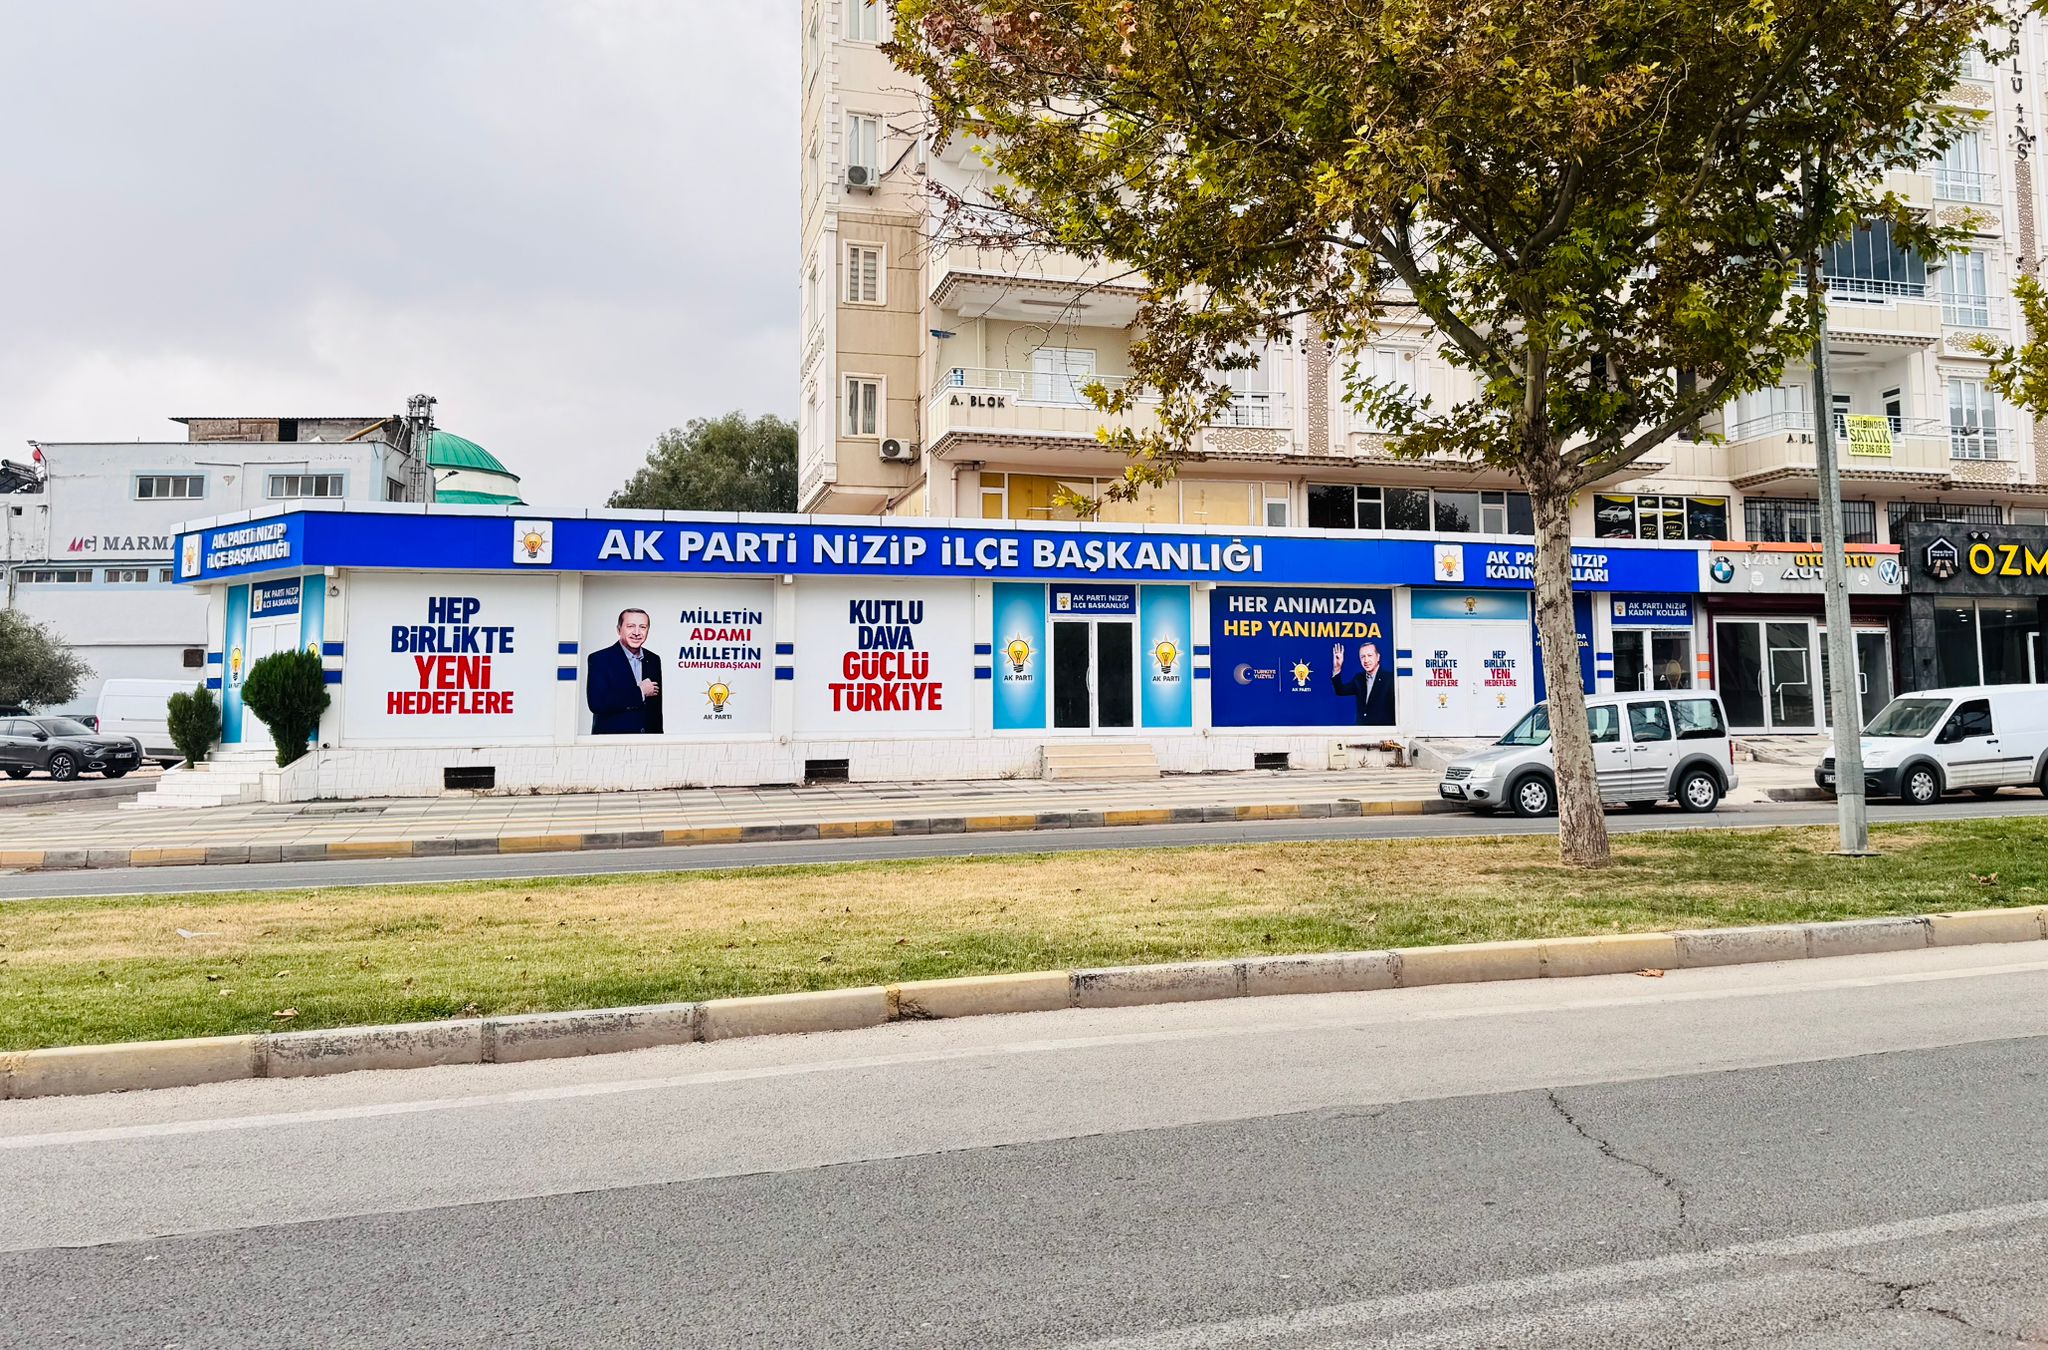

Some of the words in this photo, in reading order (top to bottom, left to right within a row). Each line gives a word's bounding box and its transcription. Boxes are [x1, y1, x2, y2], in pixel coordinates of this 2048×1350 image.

[950, 394, 964, 406] A.
[970, 395, 1005, 408] BLOK
[1847, 417, 1888, 430] SAHİBİNDEN
[1801, 433, 1814, 445] BL
[1849, 428, 1890, 443] SATILIK
[103, 536, 176, 550] MARM
[211, 532, 228, 550] AK
[228, 527, 257, 547] PARTİ
[256, 523, 287, 542] NİZİP
[207, 551, 229, 570] İLÇE
[228, 539, 291, 566] BAŞKANLIĞI
[598, 529, 665, 560] AK
[679, 531, 797, 563] PARTİ
[813, 533, 927, 565] NİZİP
[941, 535, 1019, 569] İLÇE
[1033, 538, 1263, 572] BAŞKANLIĞI
[1486, 551, 1510, 564] AK
[1571, 568, 1609, 582] LLARI
[1781, 568, 1824, 580] AUT
[428, 597, 481, 624] HEP
[849, 599, 924, 624] KUTLU
[1229, 596, 1268, 612] HER
[1273, 597, 1377, 615] ANIMIZDA
[680, 606, 762, 624] MİLLETİN
[690, 628, 751, 641] ADAMI
[1223, 620, 1263, 636] HEP
[1267, 621, 1382, 638] YANIMIZDA
[391, 626, 515, 653] BİRLİKTE
[858, 625, 914, 650] DAVA
[678, 643, 762, 660] MİLLETİN
[1434, 650, 1448, 659] HEP
[1492, 650, 1507, 659] HEP
[678, 661, 761, 671] CUMHURBAŞKANI
[842, 651, 929, 681] GÜÇLÜ
[1425, 659, 1458, 668] BİRLİKTE
[1484, 659, 1516, 668] BİRLİKTE
[414, 655, 491, 690] YENİ
[1432, 668, 1452, 679] YENİ
[1490, 668, 1511, 679] YENİ
[1426, 679, 1458, 687] HEDEFLERE
[1484, 679, 1517, 687] HEDEFLERE
[387, 691, 514, 714] HEDEFLERE
[828, 682, 943, 712] TÜRKİYE
